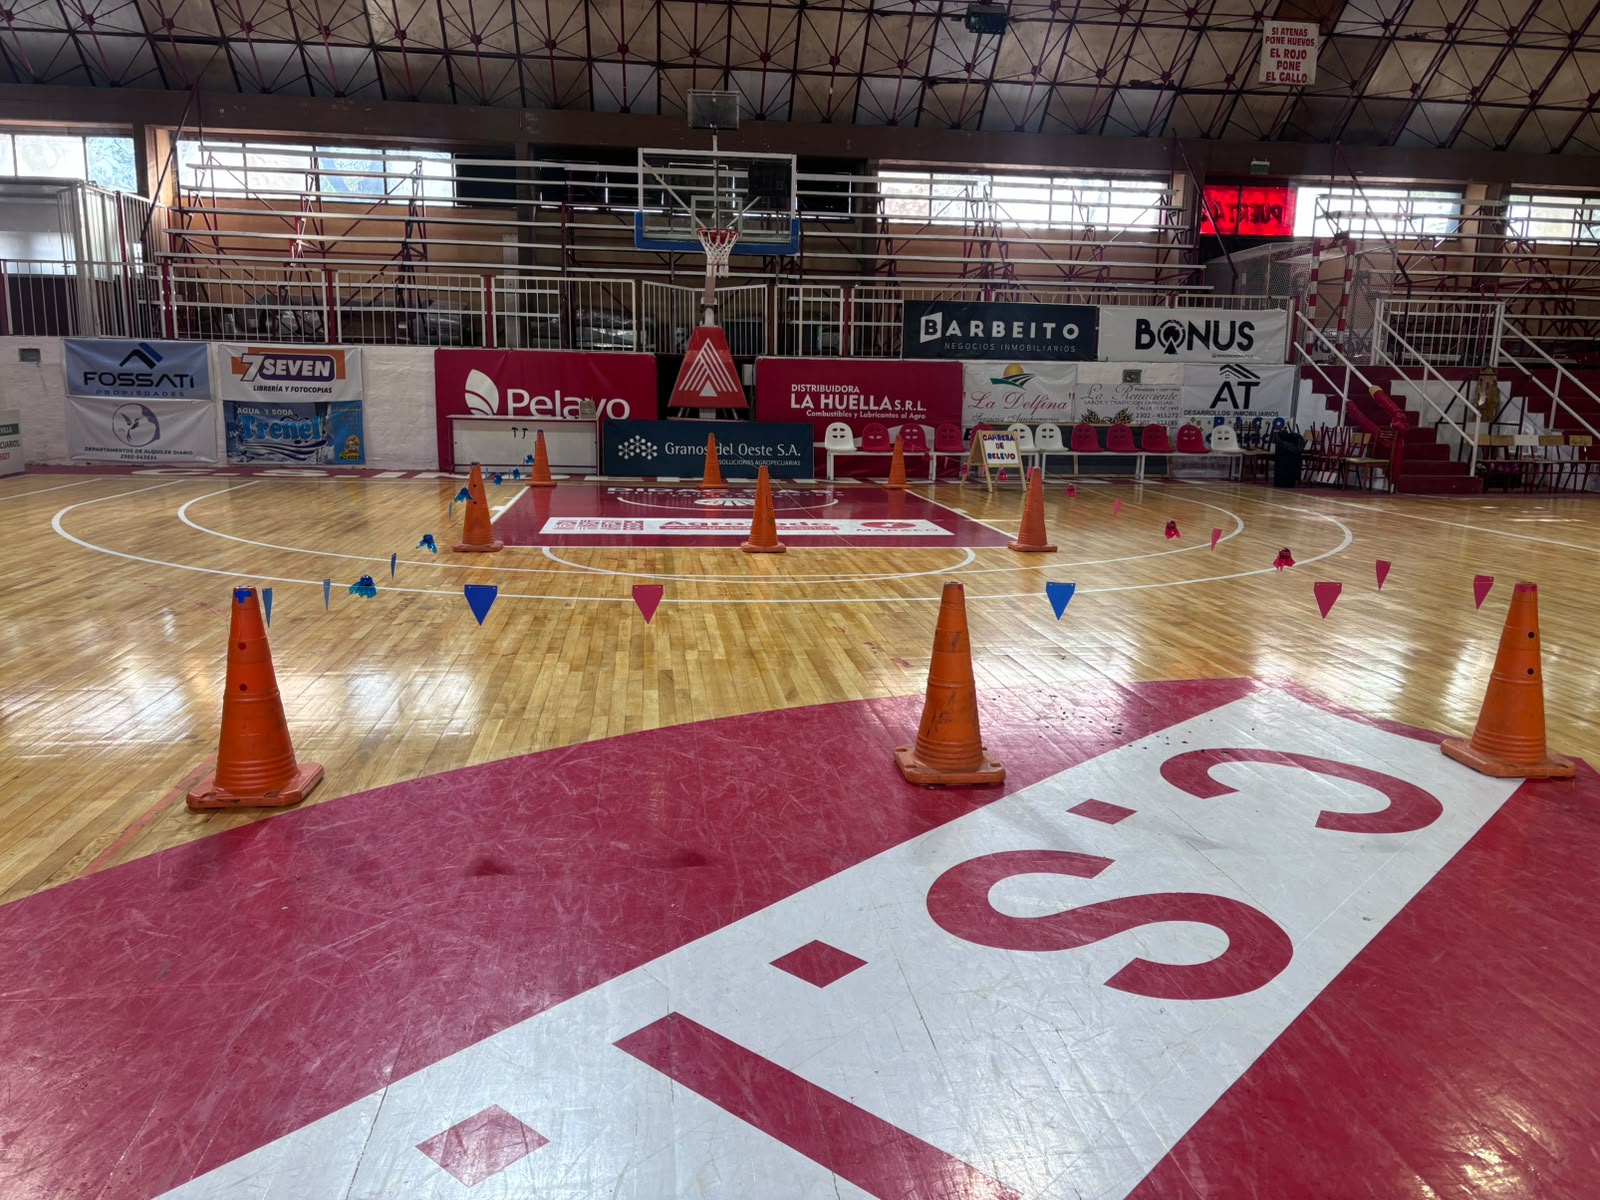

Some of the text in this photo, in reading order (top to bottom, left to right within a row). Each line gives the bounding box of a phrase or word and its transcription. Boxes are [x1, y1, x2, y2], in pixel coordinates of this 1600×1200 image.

[1271, 26, 1308, 37] SI ATENAS
[1265, 36, 1286, 45] PONE
[1269, 48, 1307, 60] EL ROJO
[1276, 60, 1302, 72] PONE
[1265, 71, 1308, 84] EL GALLO
[922, 316, 1079, 340] BARBEITO
[1135, 317, 1256, 354] BONUS
[944, 342, 1076, 353] NEGOCIOS INMOBILIARIOS
[83, 371, 195, 389] FOSSATI
[96, 389, 185, 397] PROPIEDADES
[253, 383, 333, 394] LIBRERÍA Y FOTOCOPIAS
[791, 383, 860, 393] DISTRIBUIDORA
[1209, 381, 1261, 410] AT
[790, 393, 927, 412] LA HUELLA S.R.L.
[237, 406, 260, 415] AGUA
[271, 408, 294, 416] SODA
[806, 409, 852, 418] Combustibles
[859, 410, 899, 419] Lubricantes
[900, 411, 908, 419] al
[909, 412, 926, 421] Agro
[738, 444, 773, 457] Oeste
[777, 443, 801, 457] S.A.
[719, 458, 801, 467] SOLUCIONES AGROPECUARIAS
